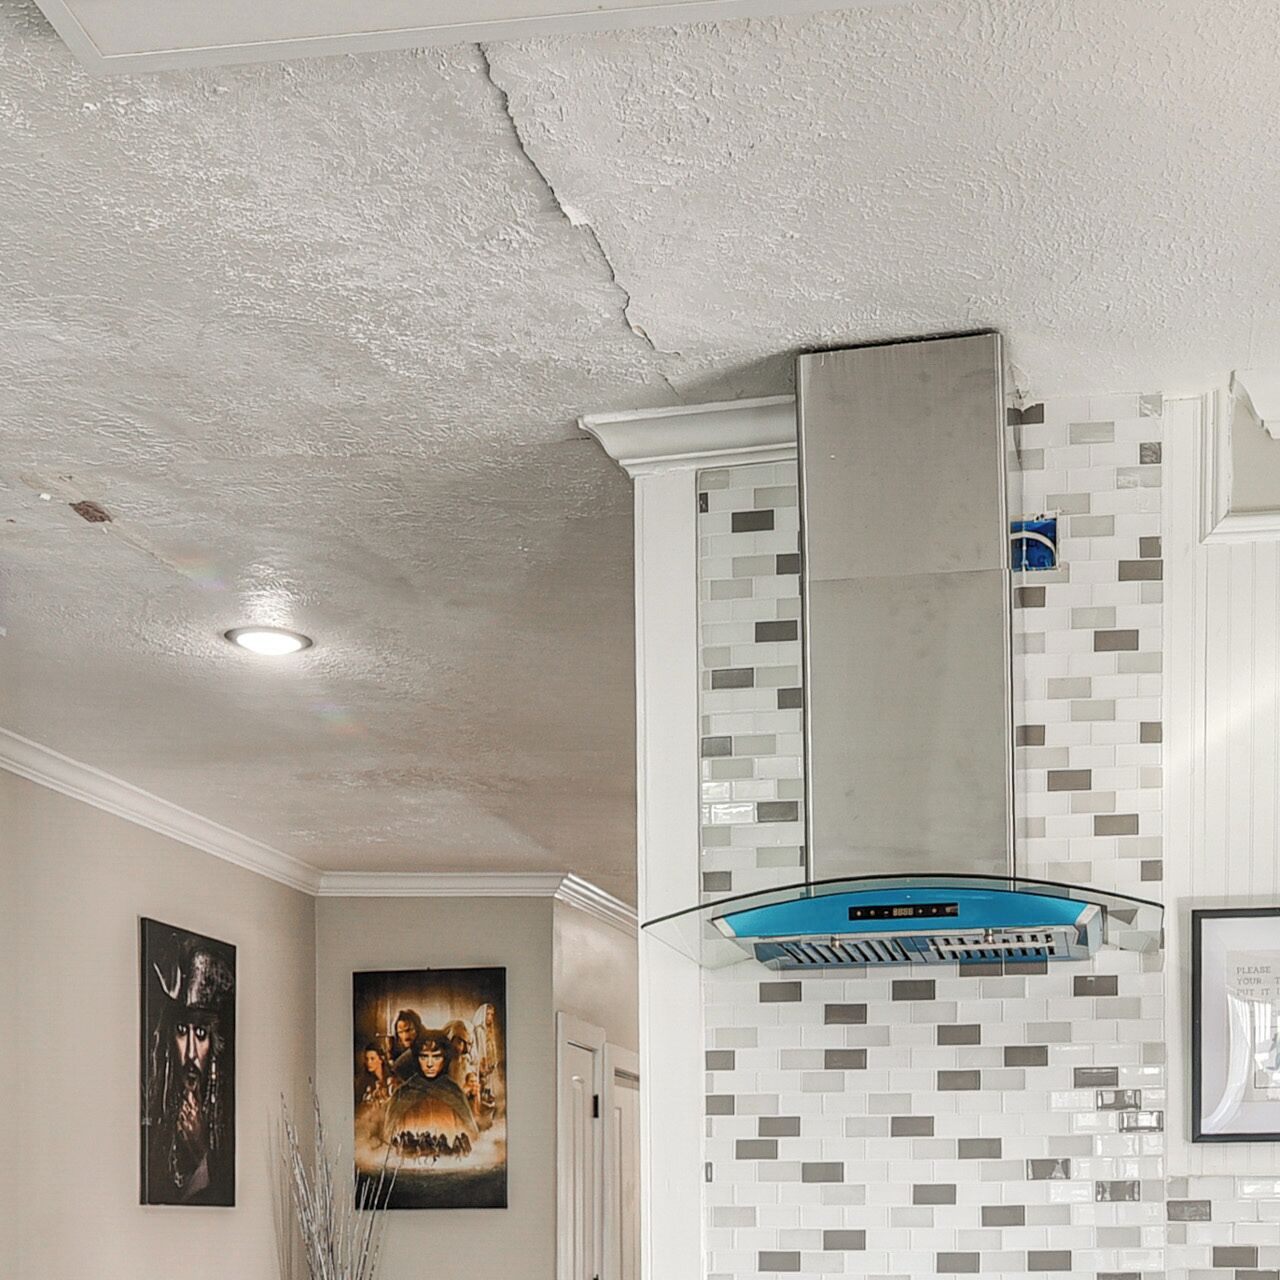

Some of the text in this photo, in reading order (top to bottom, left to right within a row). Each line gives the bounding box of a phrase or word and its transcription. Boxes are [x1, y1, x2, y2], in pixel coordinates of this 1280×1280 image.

[1236, 966, 1271, 974] PLEASE
[1236, 977, 1262, 985] YOUR
[1236, 988, 1254, 996] PUT
[1260, 988, 1271, 996] IT
